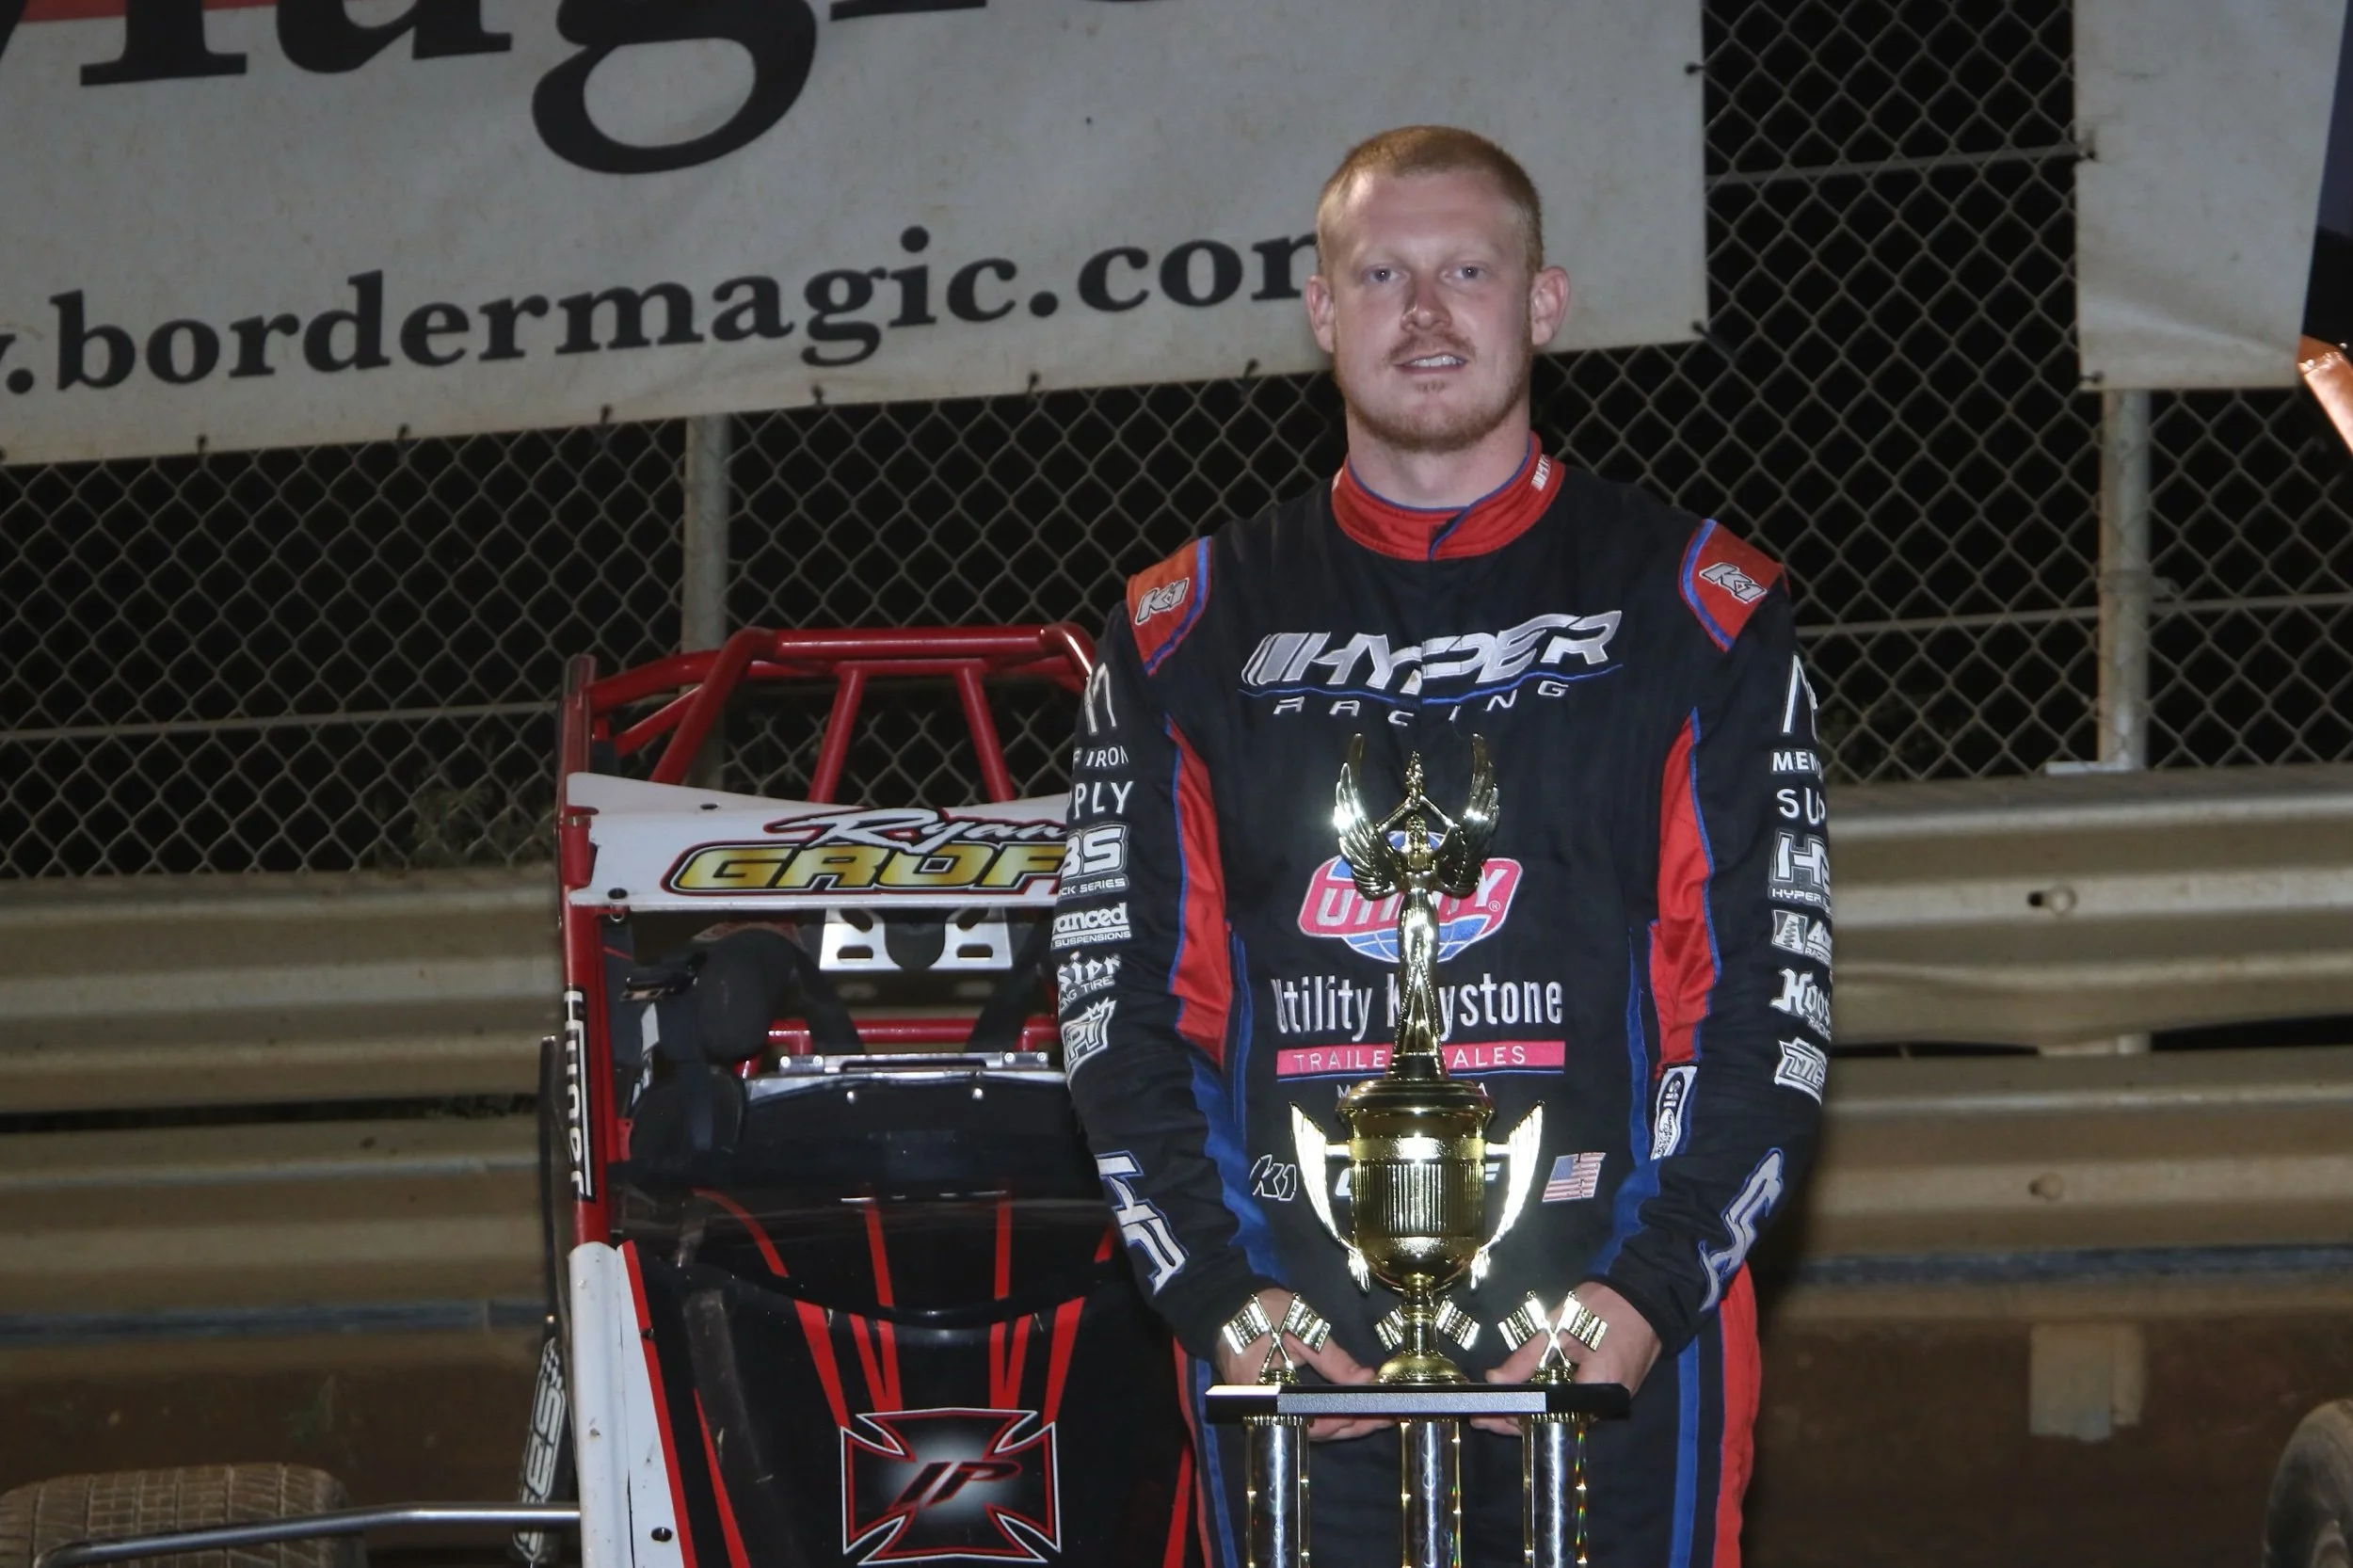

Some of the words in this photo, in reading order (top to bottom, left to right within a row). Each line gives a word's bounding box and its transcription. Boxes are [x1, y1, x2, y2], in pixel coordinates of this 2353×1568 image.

[0, 226, 1316, 395] .bordermagic.co
[1135, 577, 1190, 626] K1
[1699, 562, 1768, 603] K1
[1241, 610, 1623, 696] HYPER
[1273, 680, 1570, 728] RACING
[1069, 780, 1133, 820] PLY
[670, 842, 1064, 891] GROF
[1059, 885, 1077, 897] CK
[1080, 877, 1127, 893] SERIES
[1771, 888, 1822, 904] HYPER
[1054, 931, 1132, 949] SUSPENSIONS
[1080, 974, 1115, 994] TIRE
[1386, 972, 1563, 1042] Kystone
[1293, 1049, 1387, 1070] TRAILE
[1449, 1045, 1527, 1067] ALES
